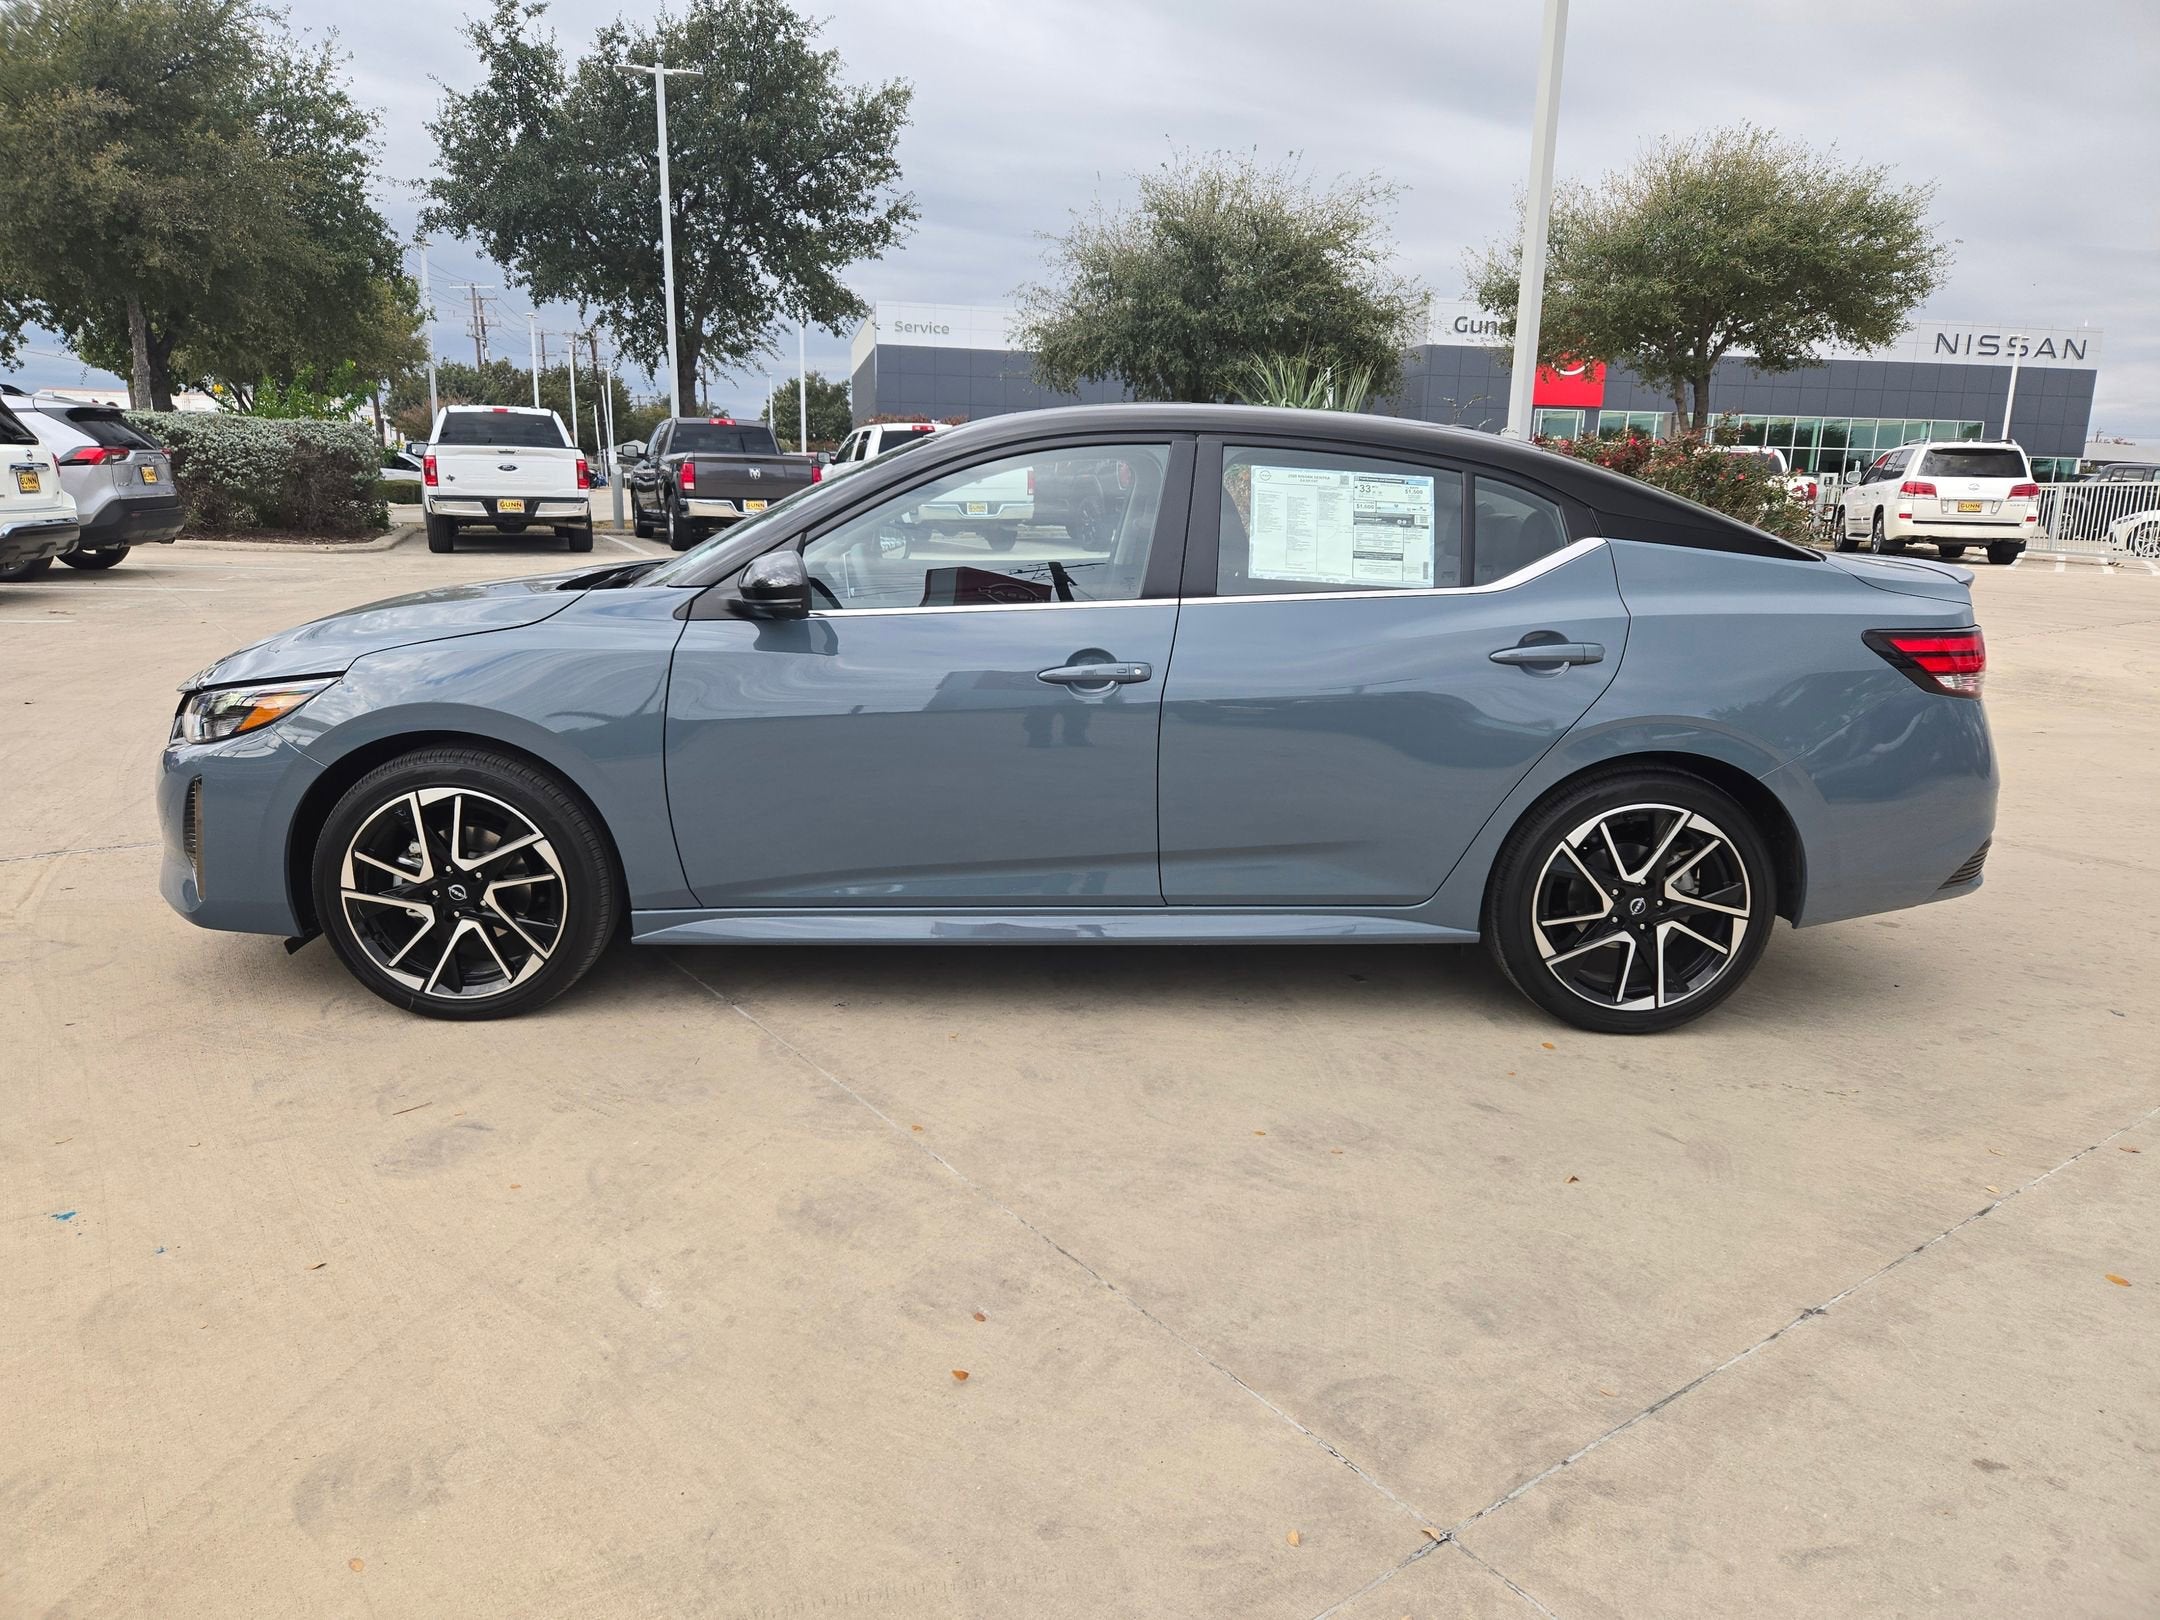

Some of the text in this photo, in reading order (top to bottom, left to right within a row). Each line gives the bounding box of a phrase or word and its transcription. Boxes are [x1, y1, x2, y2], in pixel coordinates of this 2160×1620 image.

[894, 320, 950, 335] Service
[1454, 315, 1499, 336] Gun
[1935, 332, 2087, 361] NISSAN
[1359, 484, 1371, 493] 33
